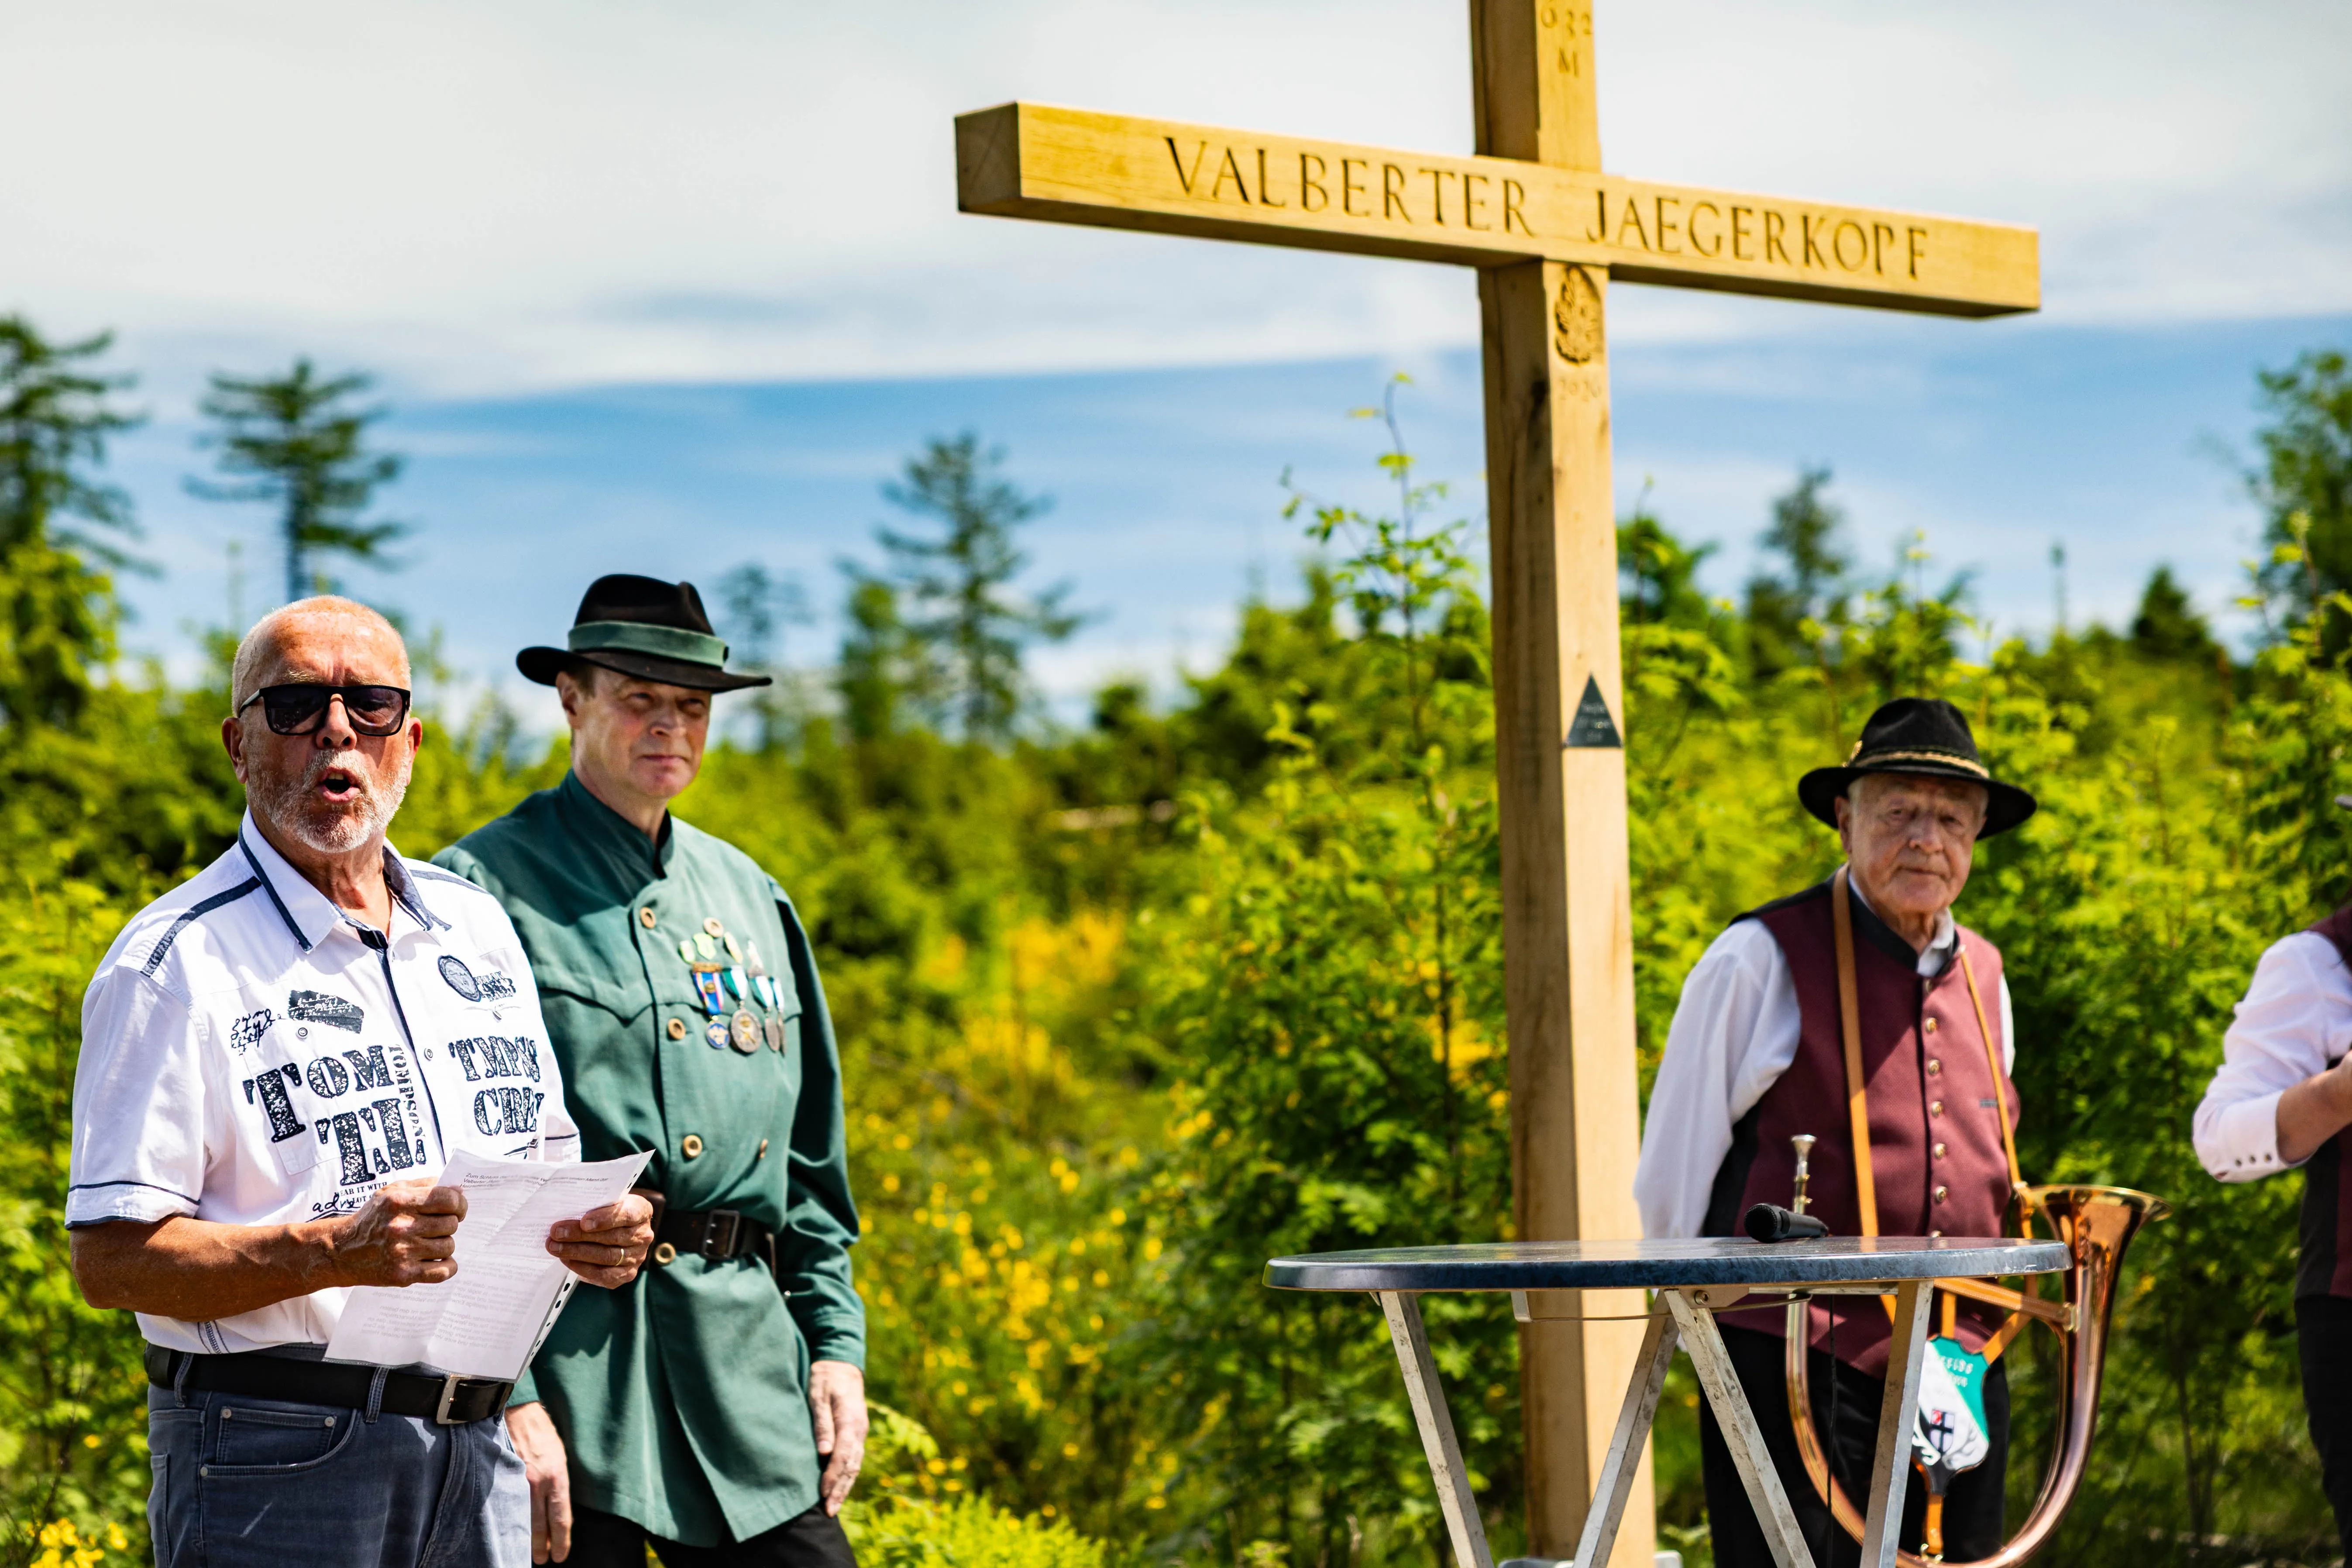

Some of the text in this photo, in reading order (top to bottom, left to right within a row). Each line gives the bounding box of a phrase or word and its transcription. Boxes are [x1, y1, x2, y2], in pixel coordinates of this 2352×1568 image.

[1163, 136, 1927, 280] VALBERTER JAEGERKOPF
[242, 1045, 395, 1143] TOM
